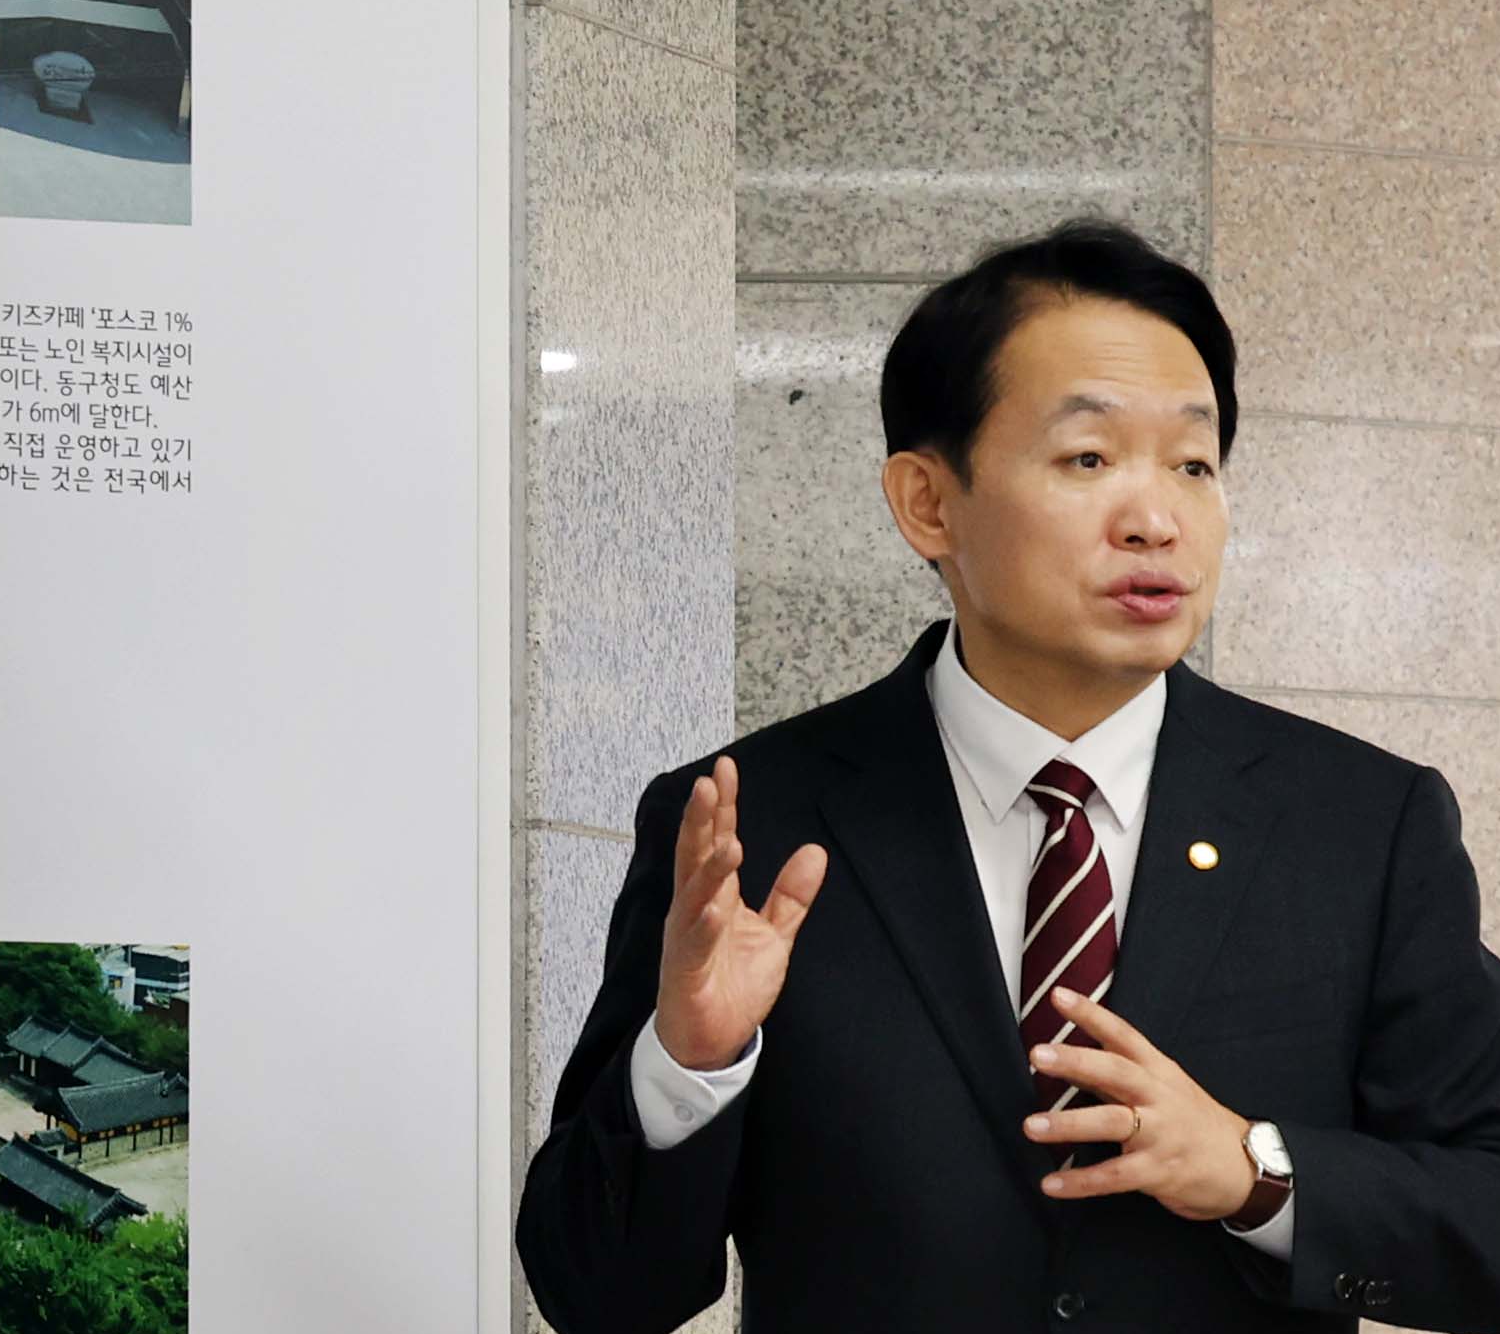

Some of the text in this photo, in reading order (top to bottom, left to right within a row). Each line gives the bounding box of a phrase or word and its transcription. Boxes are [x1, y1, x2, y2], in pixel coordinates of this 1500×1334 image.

[1, 303, 85, 330] 키즈카페
[164, 311, 193, 333] 1%
[44, 338, 85, 365] 노인
[90, 339, 192, 369] 복지시설이
[55, 370, 143, 399] 동구청도
[149, 374, 193, 401] 예산
[29, 401, 81, 426] 6m에
[88, 402, 159, 431] 달한다.
[3, 431, 192, 464] 직접 운영하고 있기
[50, 465, 94, 494] 것은
[103, 467, 192, 495] 전국에서
